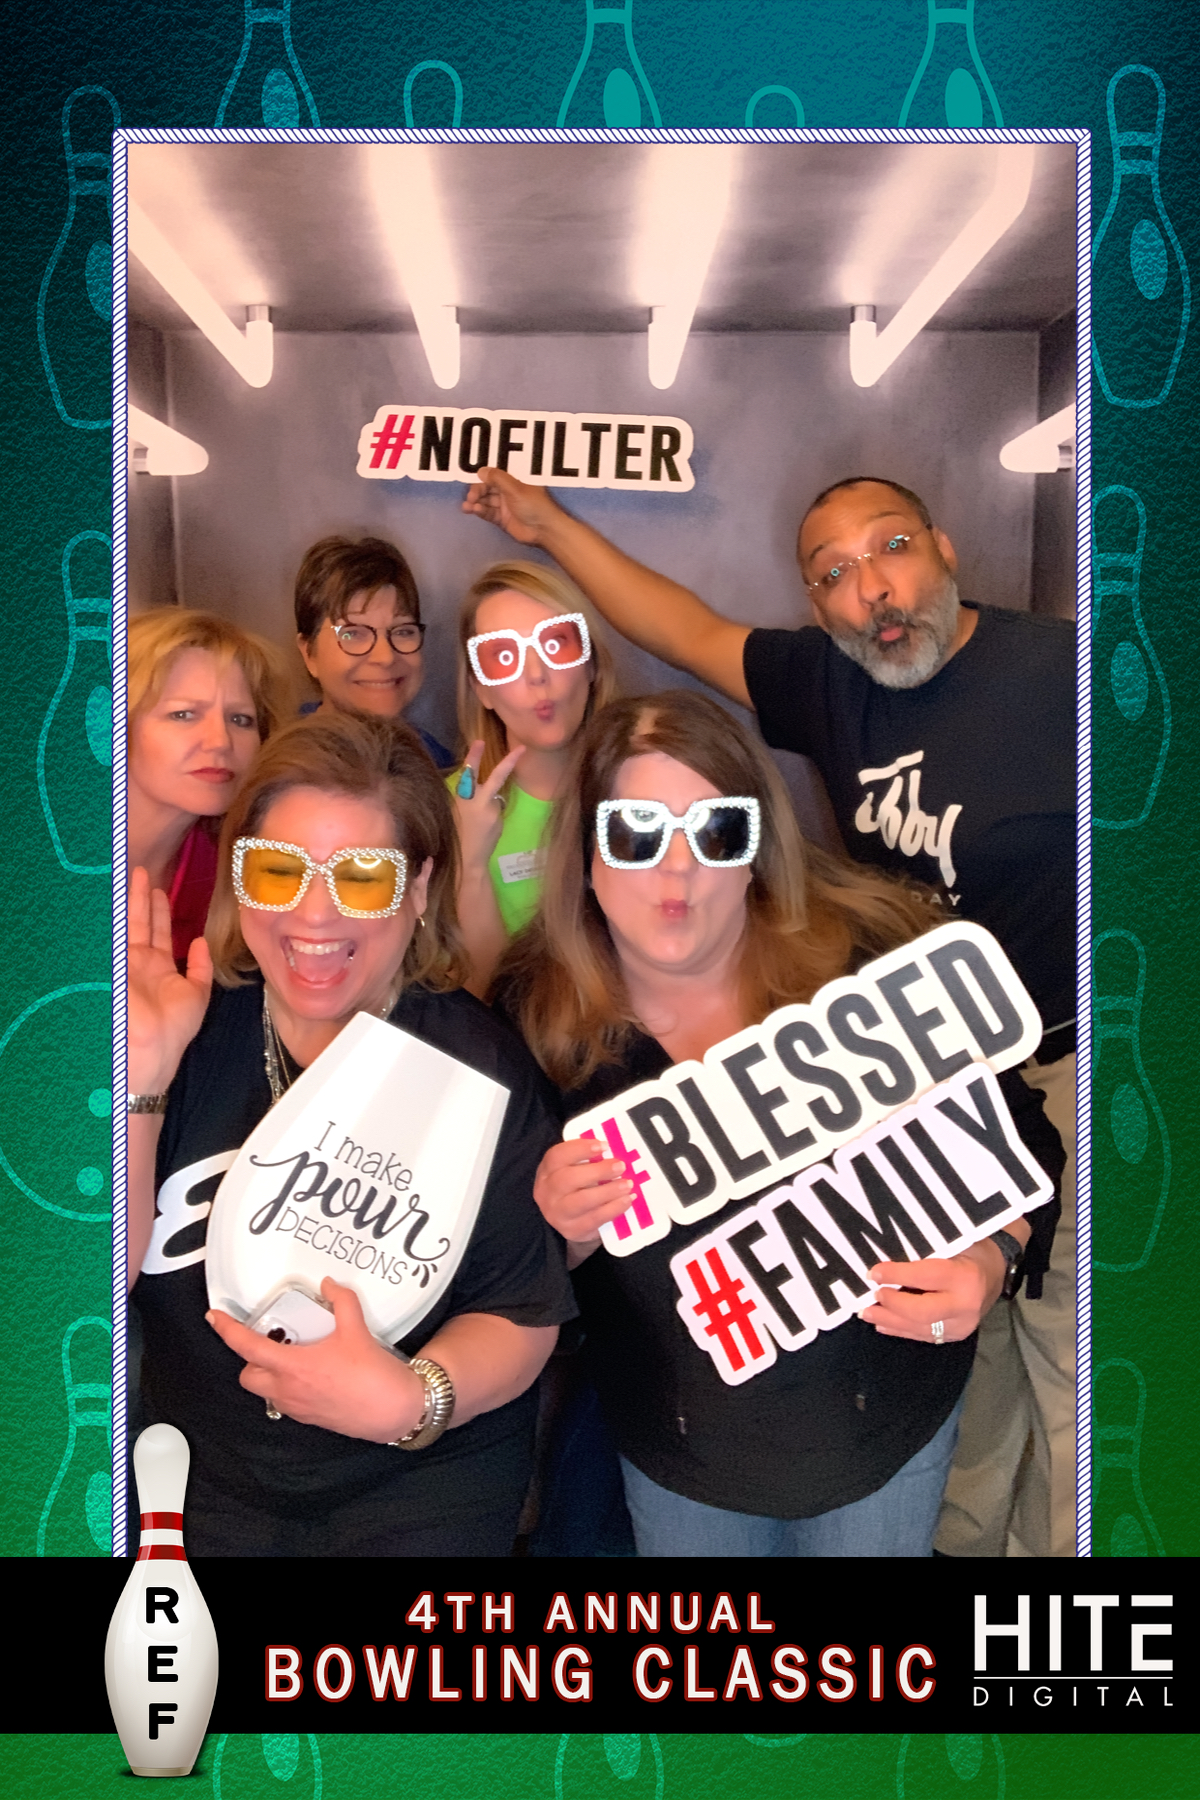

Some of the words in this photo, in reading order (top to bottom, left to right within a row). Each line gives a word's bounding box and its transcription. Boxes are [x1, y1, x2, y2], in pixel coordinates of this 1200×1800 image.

[369, 414, 682, 482] #NOFILTER
[314, 1121, 336, 1151] I
[334, 1136, 413, 1192] make
[249, 1151, 451, 1262] pour
[275, 1206, 408, 1285] DECISIONS
[685, 1077, 1042, 1372] #FAMILY
